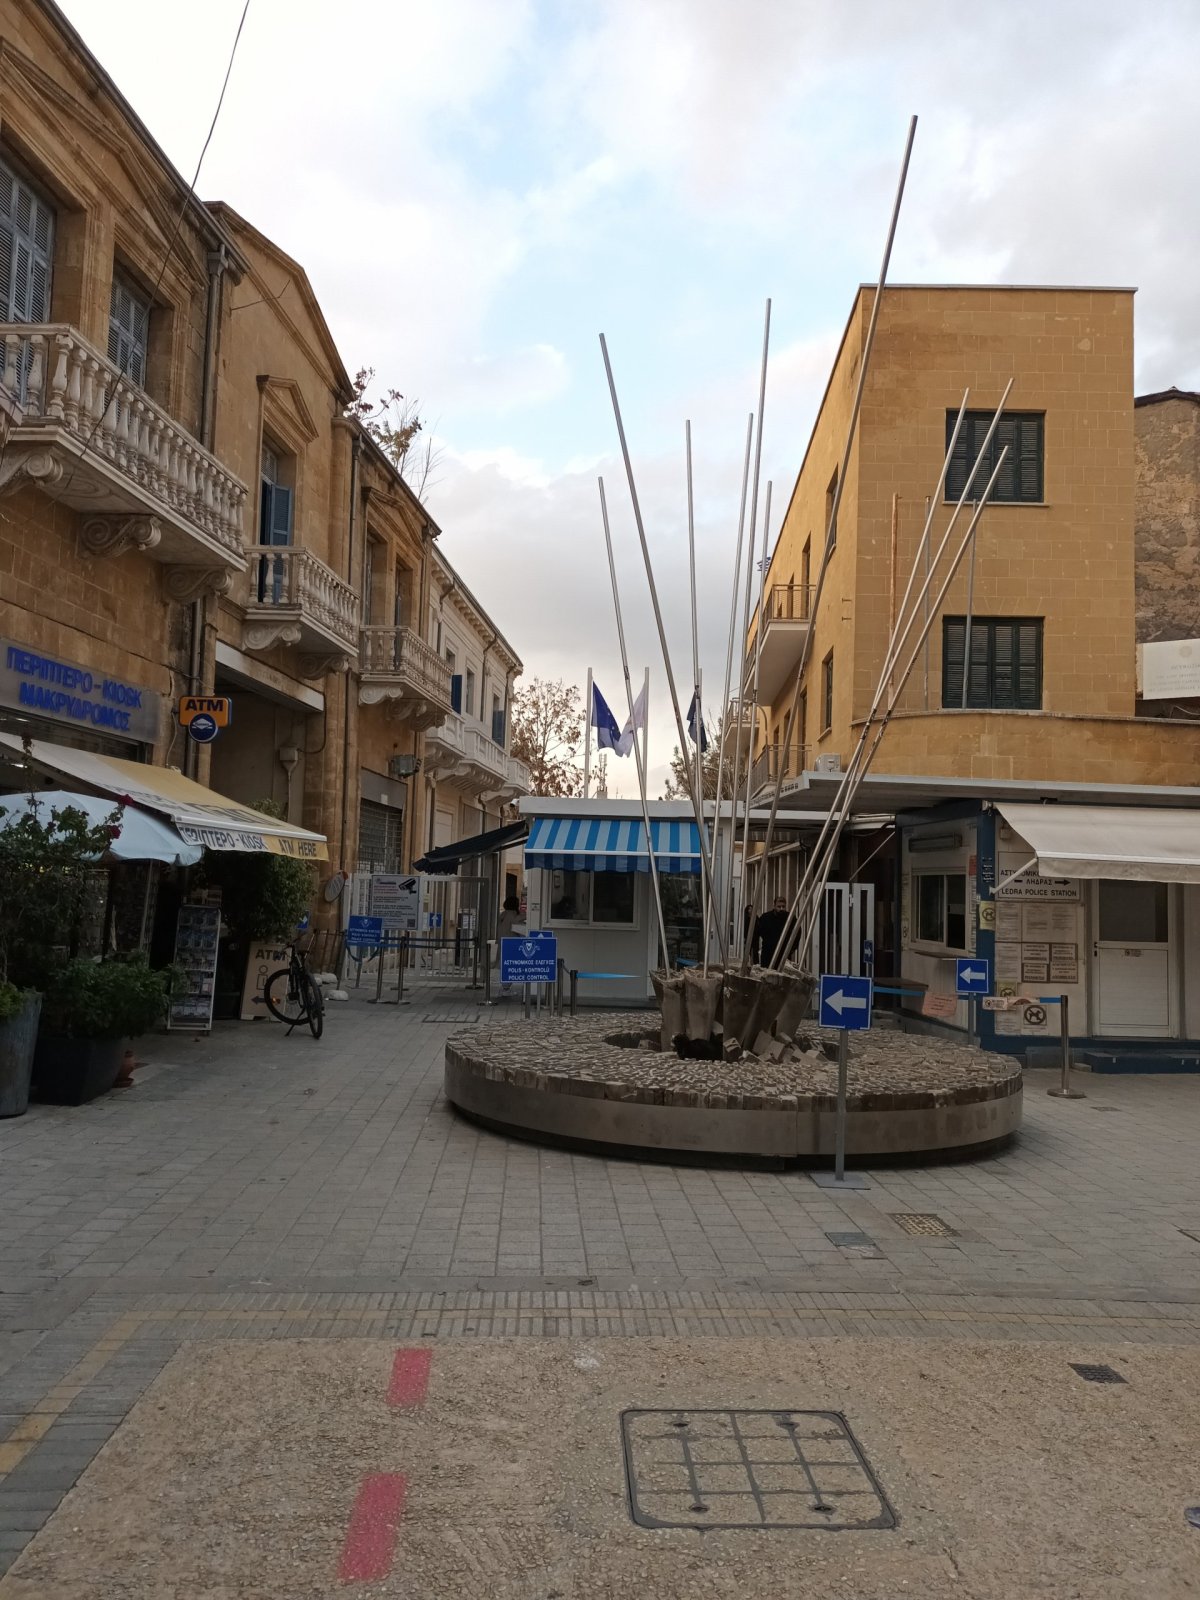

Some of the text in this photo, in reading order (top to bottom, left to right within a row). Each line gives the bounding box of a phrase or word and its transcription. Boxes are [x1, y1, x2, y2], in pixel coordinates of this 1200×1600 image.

[7, 646, 93, 693] ΠΕΡΙΠΤΕΡΟ
[102, 679, 142, 708] KIOSK
[19, 681, 131, 731] ΜΑΚΡΥΔΡΟΜΟΣ
[185, 699, 223, 711] ATM
[239, 833, 268, 850] KIOSK
[278, 838, 294, 855] ATM
[298, 841, 317, 857] HERE
[1051, 889, 1077, 897] STATION
